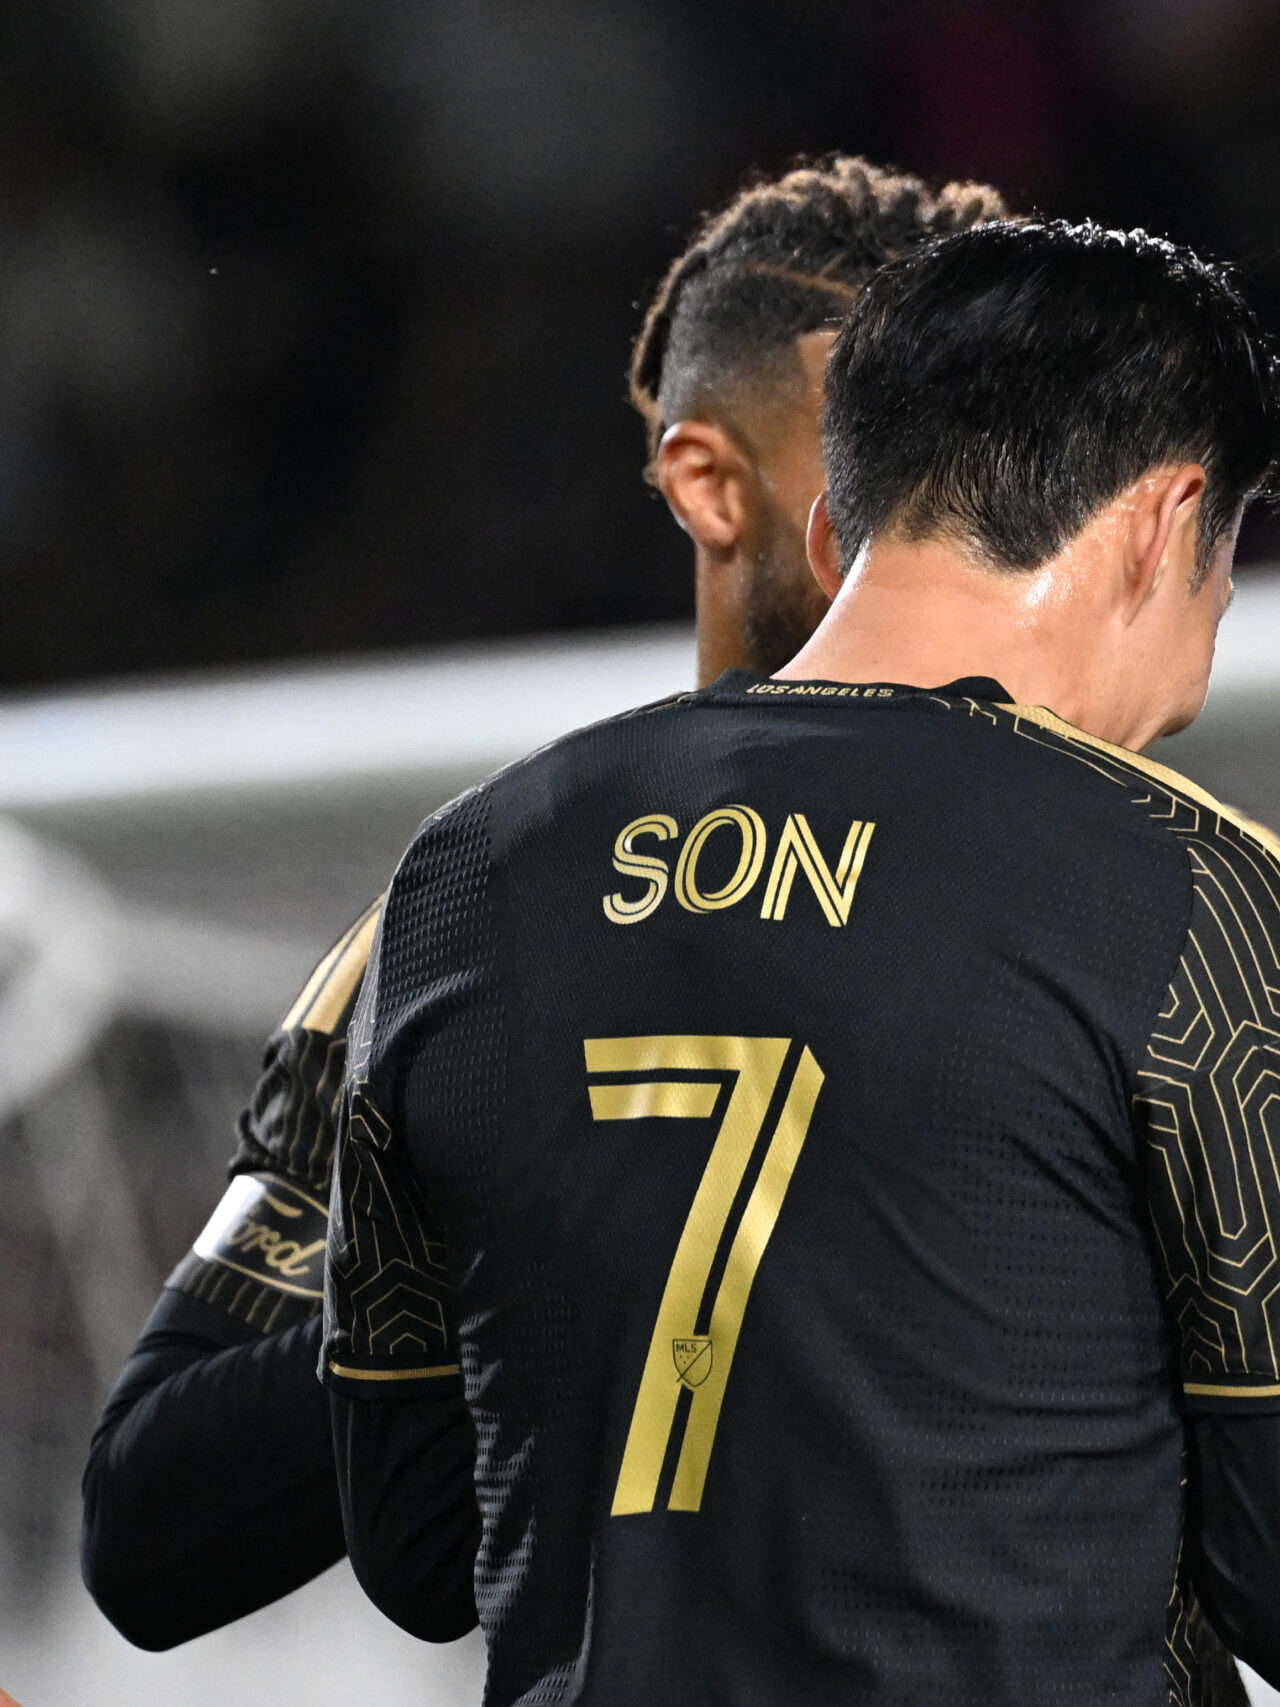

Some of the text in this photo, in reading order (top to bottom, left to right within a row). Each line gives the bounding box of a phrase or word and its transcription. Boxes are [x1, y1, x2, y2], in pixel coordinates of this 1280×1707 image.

[746, 683, 895, 698] LOS ANGELES
[602, 803, 876, 928] SON
[583, 1035, 826, 1517] 7
[675, 1343, 697, 1353] MLS
